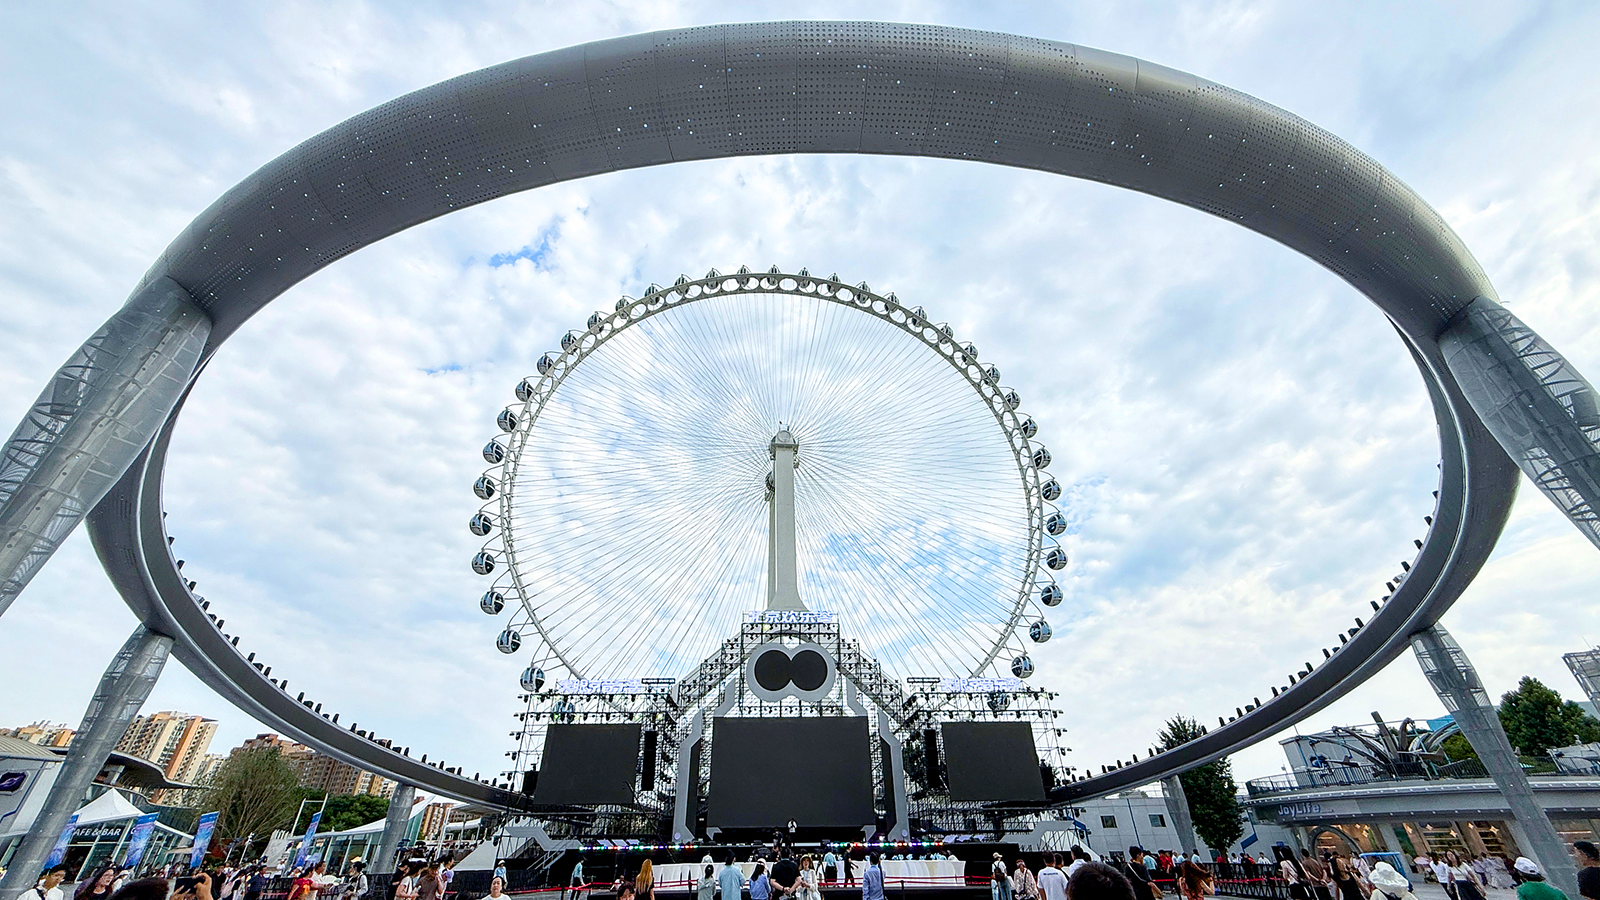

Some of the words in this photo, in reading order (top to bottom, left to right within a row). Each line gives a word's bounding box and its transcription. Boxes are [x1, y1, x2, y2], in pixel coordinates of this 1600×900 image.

[746, 609, 834, 623] 北京欢乐谷
[1278, 802, 1320, 817] JoyLife
[73, 828, 92, 836] AFE
[101, 828, 121, 836] BAR
